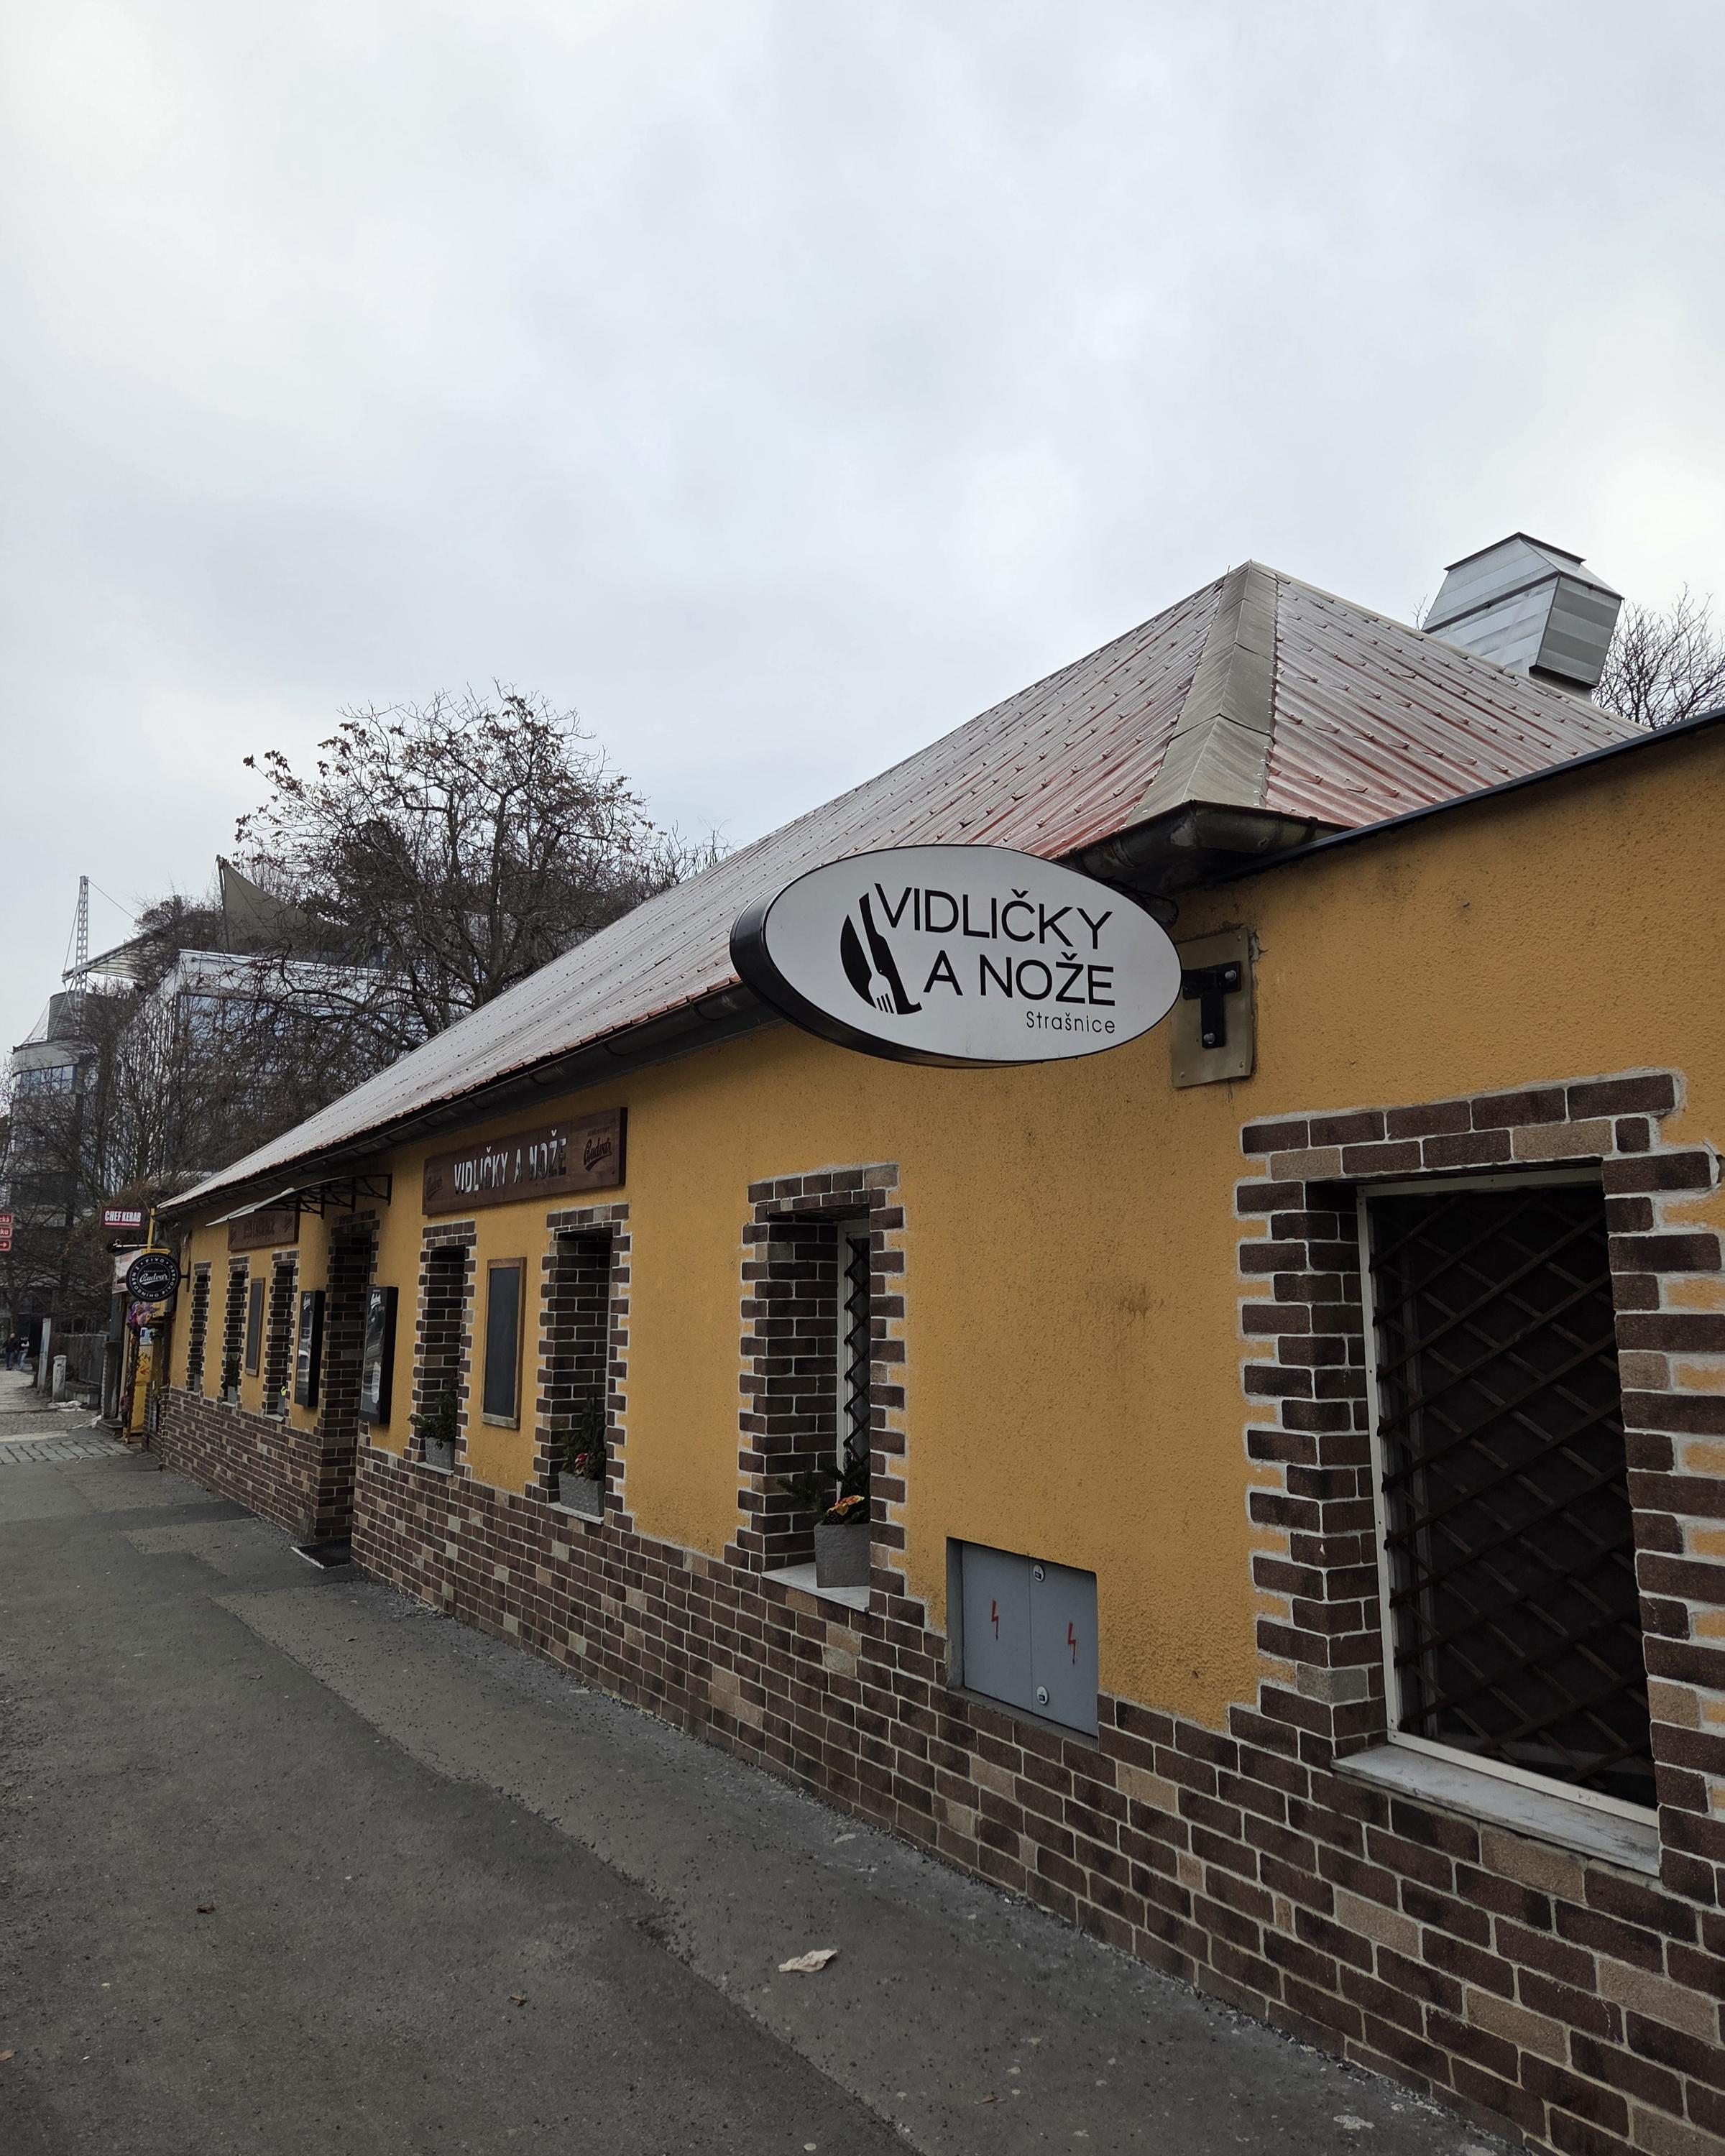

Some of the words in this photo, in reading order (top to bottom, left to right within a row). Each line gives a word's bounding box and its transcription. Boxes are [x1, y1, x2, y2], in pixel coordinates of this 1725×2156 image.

[874, 883, 1113, 950] VIDLIČKY
[923, 949, 964, 996] A
[979, 952, 1116, 1007] NOŽE
[1026, 1010, 1116, 1034] Strašnice
[454, 1146, 508, 1194] VIDLIČKY
[513, 1148, 523, 1184] A
[529, 1128, 567, 1181] NOŽE
[104, 1210, 122, 1222] CHEF
[121, 1211, 142, 1222] KEBAB
